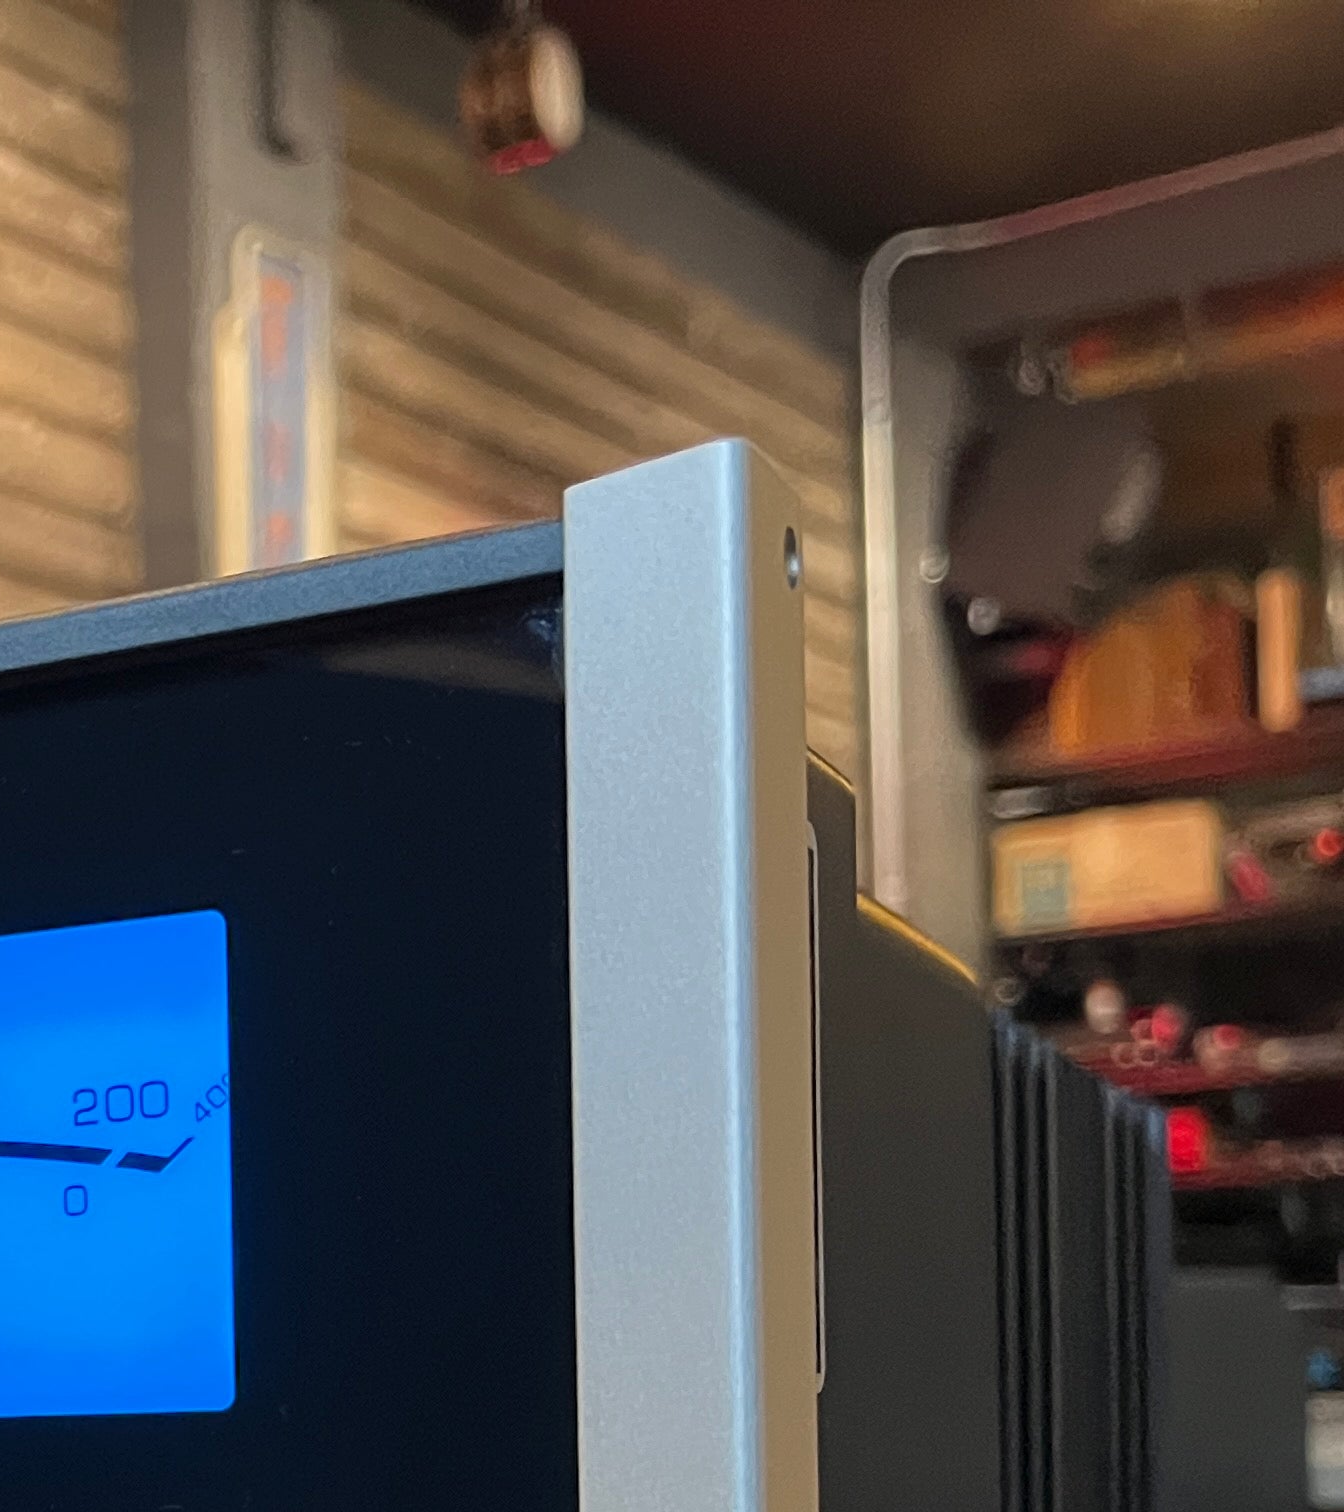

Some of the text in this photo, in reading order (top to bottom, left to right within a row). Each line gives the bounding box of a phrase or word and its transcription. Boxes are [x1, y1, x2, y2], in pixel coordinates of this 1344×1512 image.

[72, 1080, 169, 1127] 200
[194, 1073, 229, 1122] 40
[63, 1184, 89, 1217] 0
